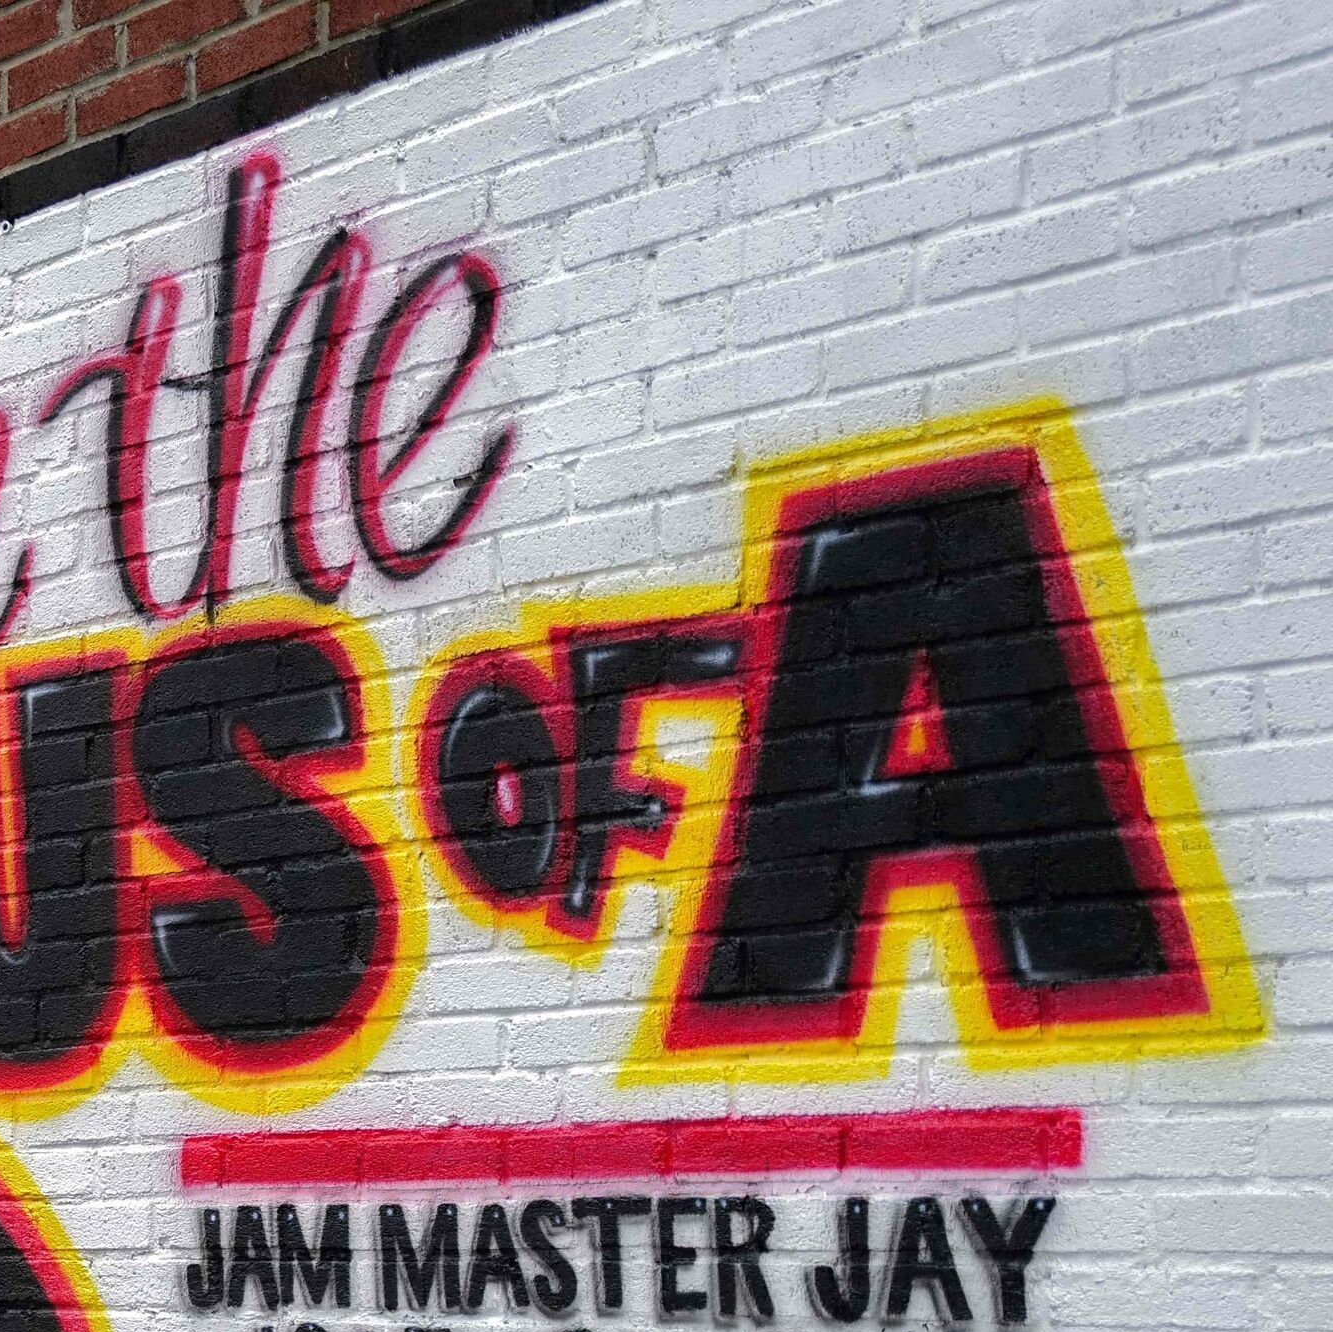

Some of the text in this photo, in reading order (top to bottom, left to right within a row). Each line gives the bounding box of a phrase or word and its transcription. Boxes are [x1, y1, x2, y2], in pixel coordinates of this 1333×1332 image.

[38, 150, 515, 625] the
[420, 612, 748, 940] OF
[663, 444, 1212, 1052] A
[186, 1196, 1057, 1325] JAM MASTER JAY
